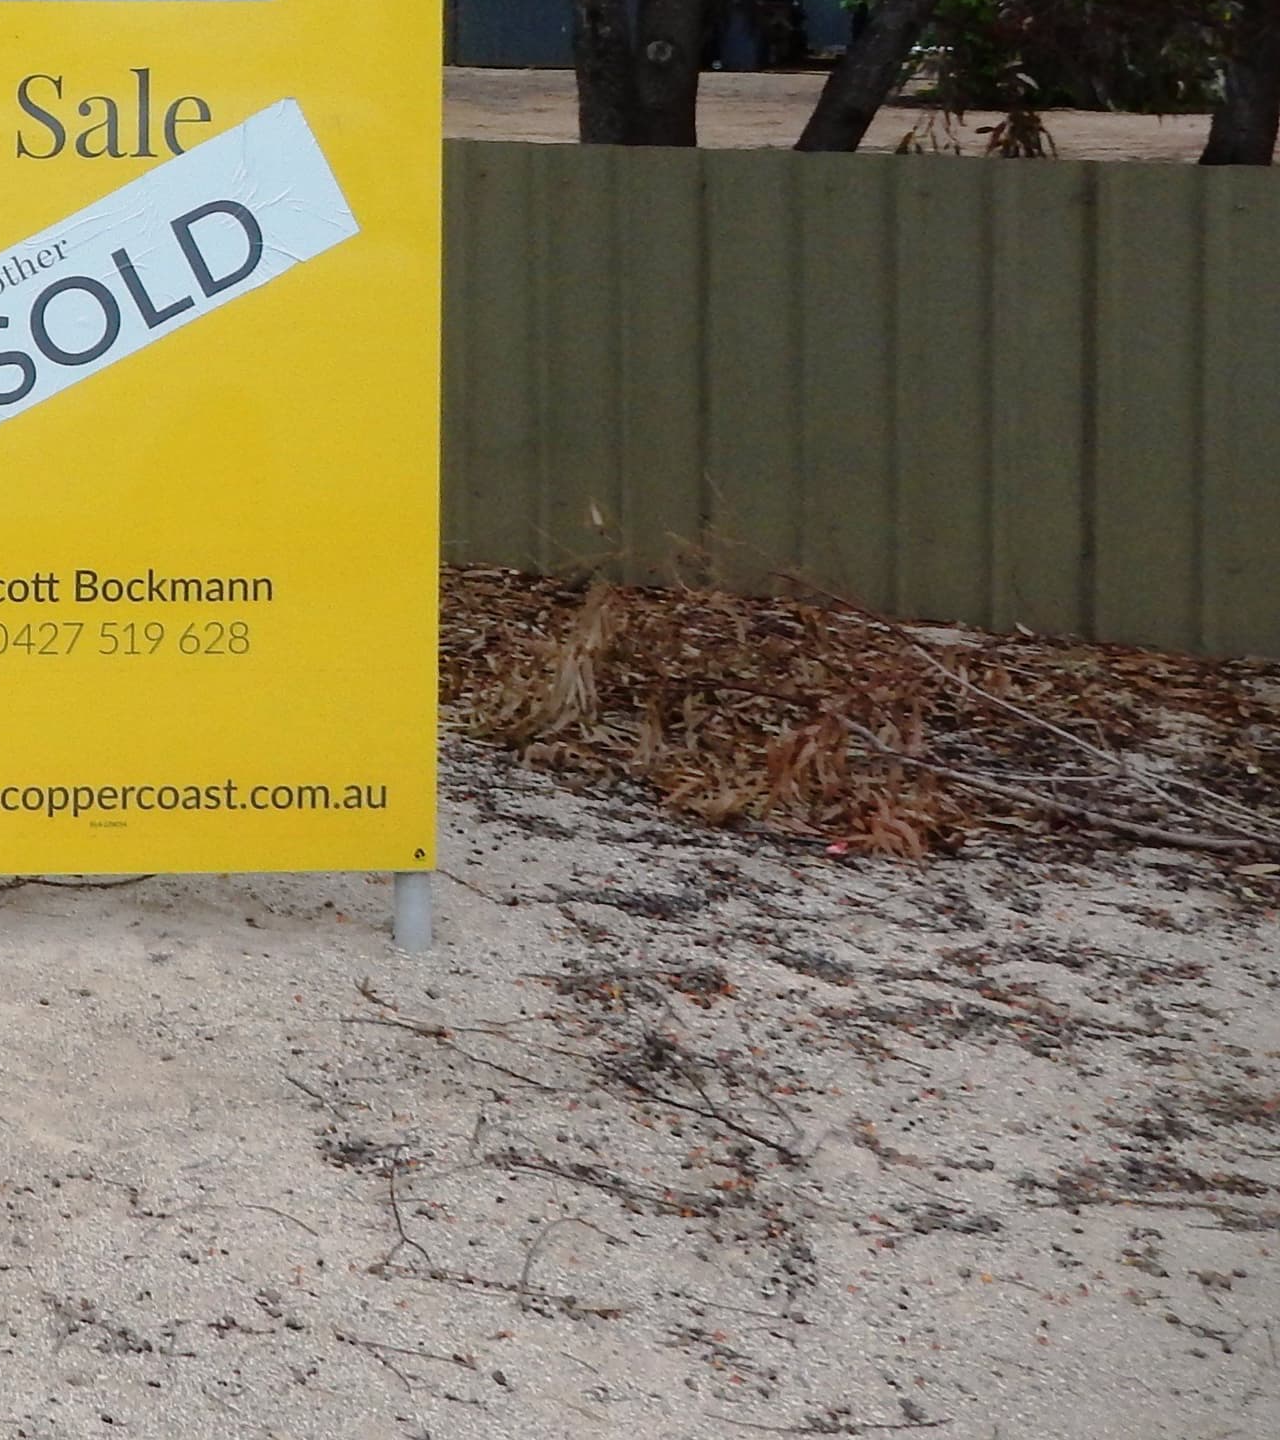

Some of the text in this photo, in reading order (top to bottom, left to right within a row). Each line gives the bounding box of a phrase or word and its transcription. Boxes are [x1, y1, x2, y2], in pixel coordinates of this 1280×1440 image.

[16, 67, 212, 160] Sale
[75, 568, 273, 603] Bockmann
[99, 622, 165, 655] 519
[179, 621, 250, 655] 628
